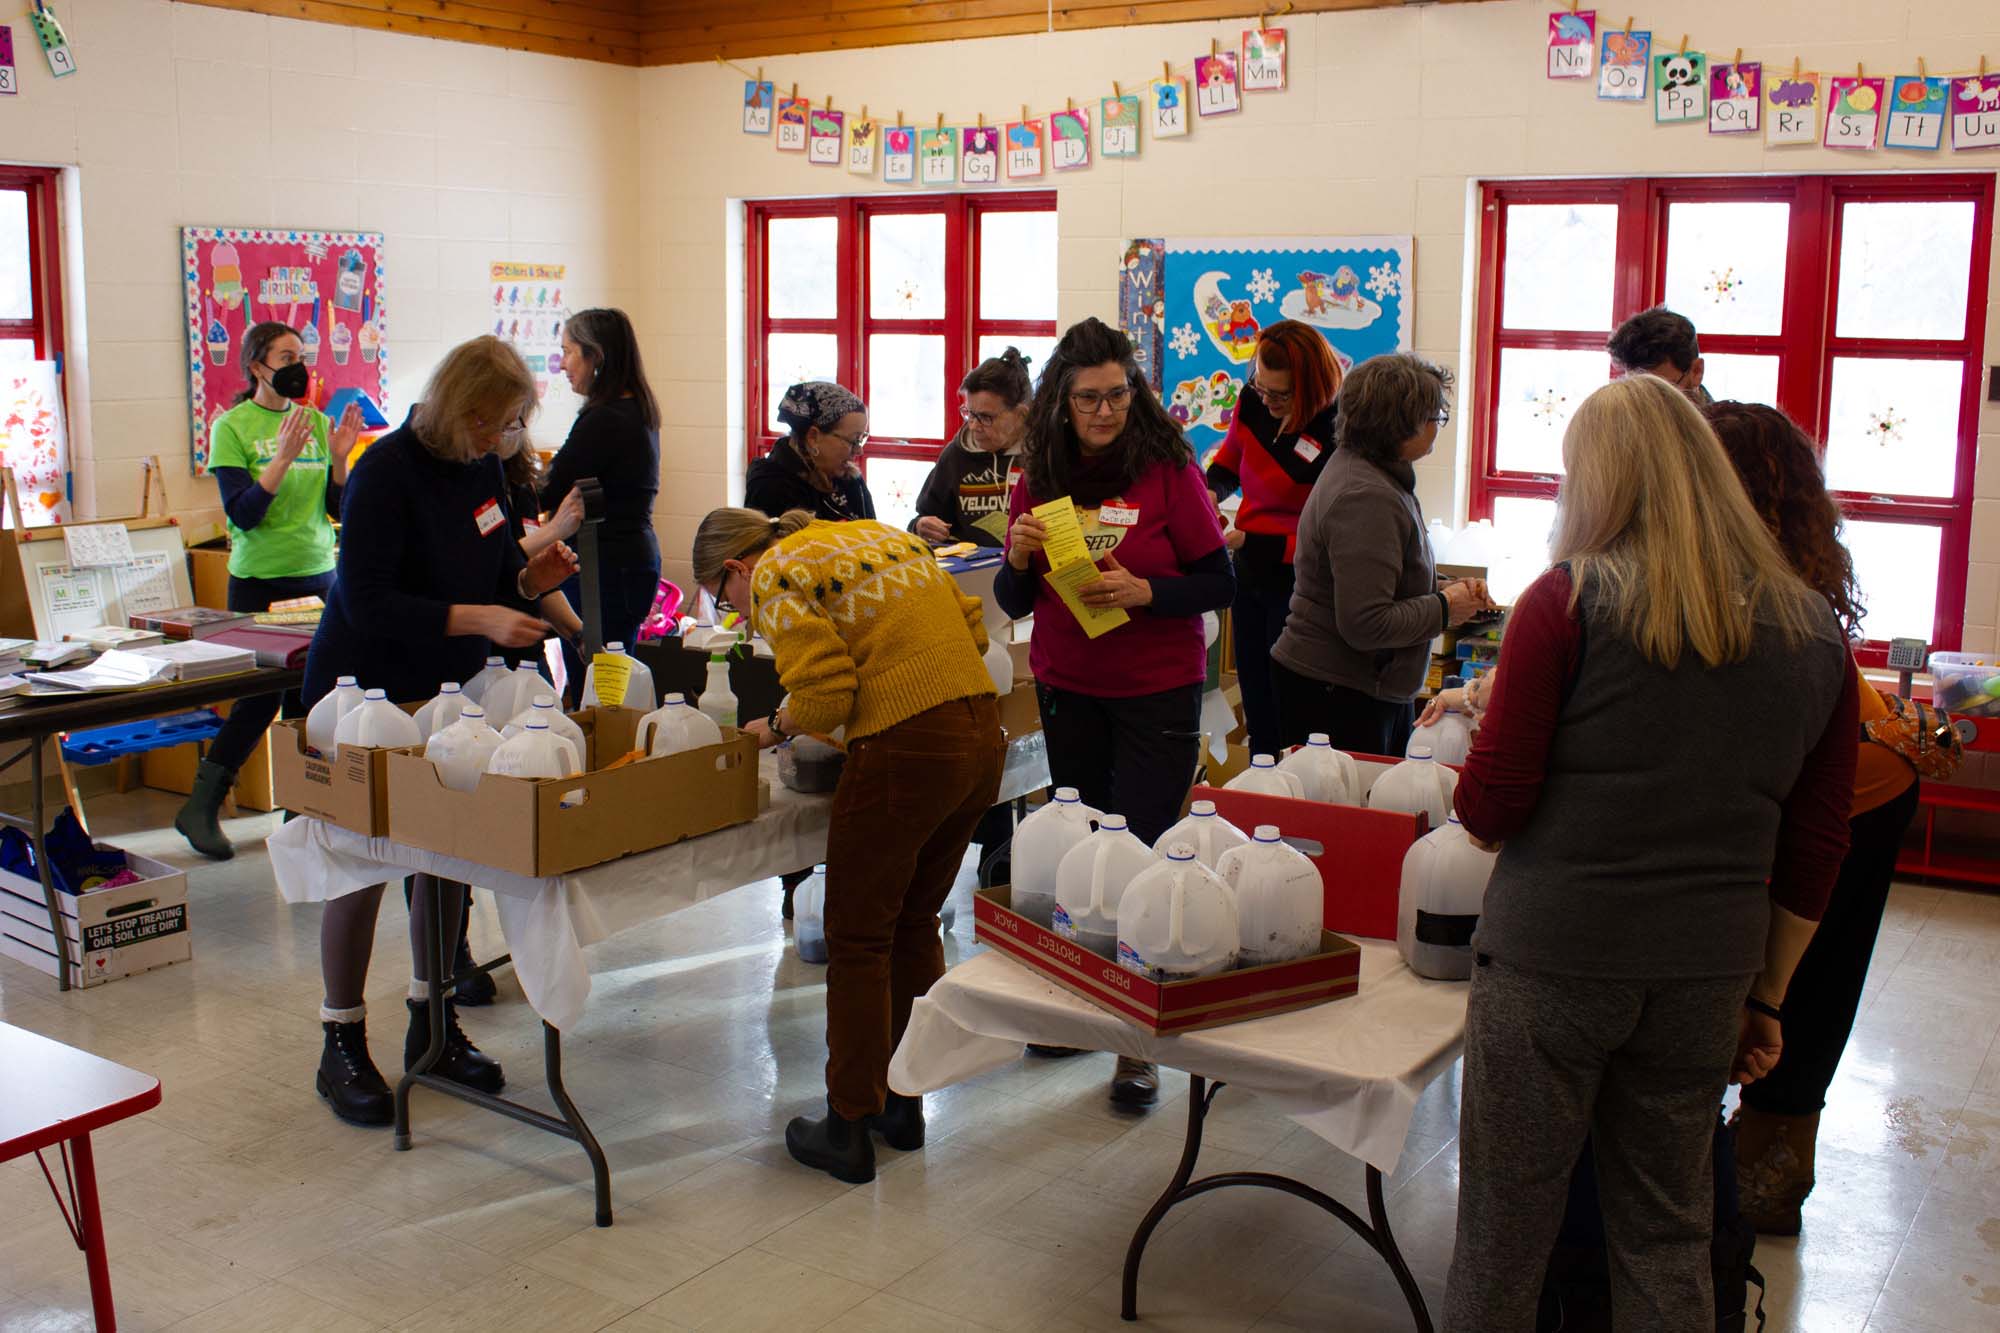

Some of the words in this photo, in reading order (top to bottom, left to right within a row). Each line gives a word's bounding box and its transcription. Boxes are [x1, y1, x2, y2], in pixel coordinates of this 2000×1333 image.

[55, 51, 69, 69] 9
[1556, 48, 1583, 67] Nn
[1248, 64, 1278, 80] Mm
[1607, 68, 1637, 87] Oo
[1668, 91, 1693, 118] Pp
[749, 110, 766, 125] Aa
[1160, 109, 1177, 128] Kk
[1716, 101, 1751, 129] Qq
[1780, 113, 1803, 133] Rr
[783, 126, 799, 142] Bb
[1840, 116, 1861, 137] Ss
[1904, 116, 1925, 137] Tt
[1965, 116, 1995, 137] Uu
[815, 139, 833, 155] Cc
[1064, 141, 1075, 159] Ii
[1112, 129, 1126, 152] Jj
[852, 148, 868, 164] Dd
[891, 156, 906, 173] Ee
[1015, 153, 1034, 169] Hh
[931, 158, 945, 175] Ff
[968, 158, 990, 180] Gg
[271, 267, 312, 281] HAPPY
[259, 279, 317, 297] BIRTHDAY
[88, 923, 112, 938] LET'S
[114, 918, 138, 931] STOP
[139, 906, 183, 923] TREATING
[993, 911, 1018, 933] PACK
[93, 935, 113, 948] OUR
[114, 930, 136, 943] SOIL
[137, 923, 157, 936] LIKE
[159, 918, 180, 931] DIRT
[1037, 934, 1081, 965] PROTECT
[1102, 968, 1131, 990] PREP
